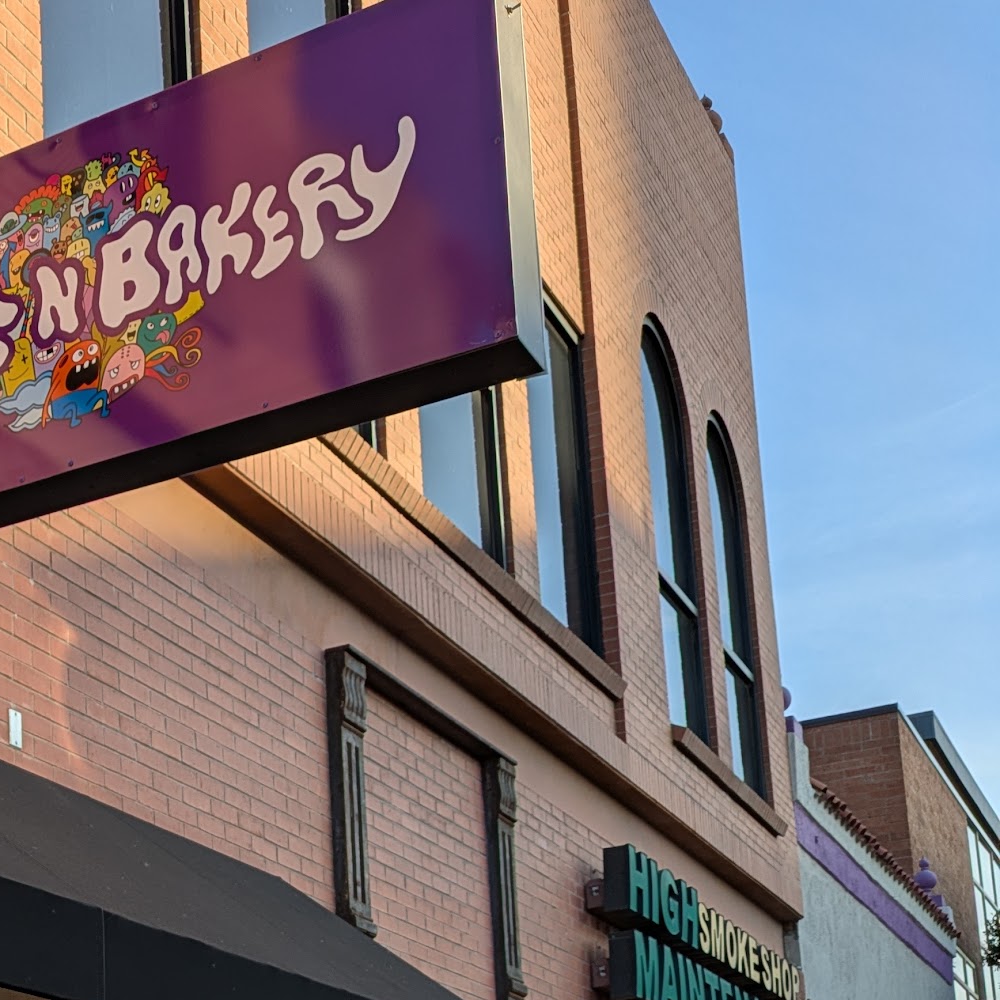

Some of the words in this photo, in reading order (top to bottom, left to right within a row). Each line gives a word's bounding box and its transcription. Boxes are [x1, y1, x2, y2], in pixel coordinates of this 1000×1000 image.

[34, 265, 80, 338] N
[100, 115, 416, 329] BAKERY
[628, 844, 699, 950] HIGH
